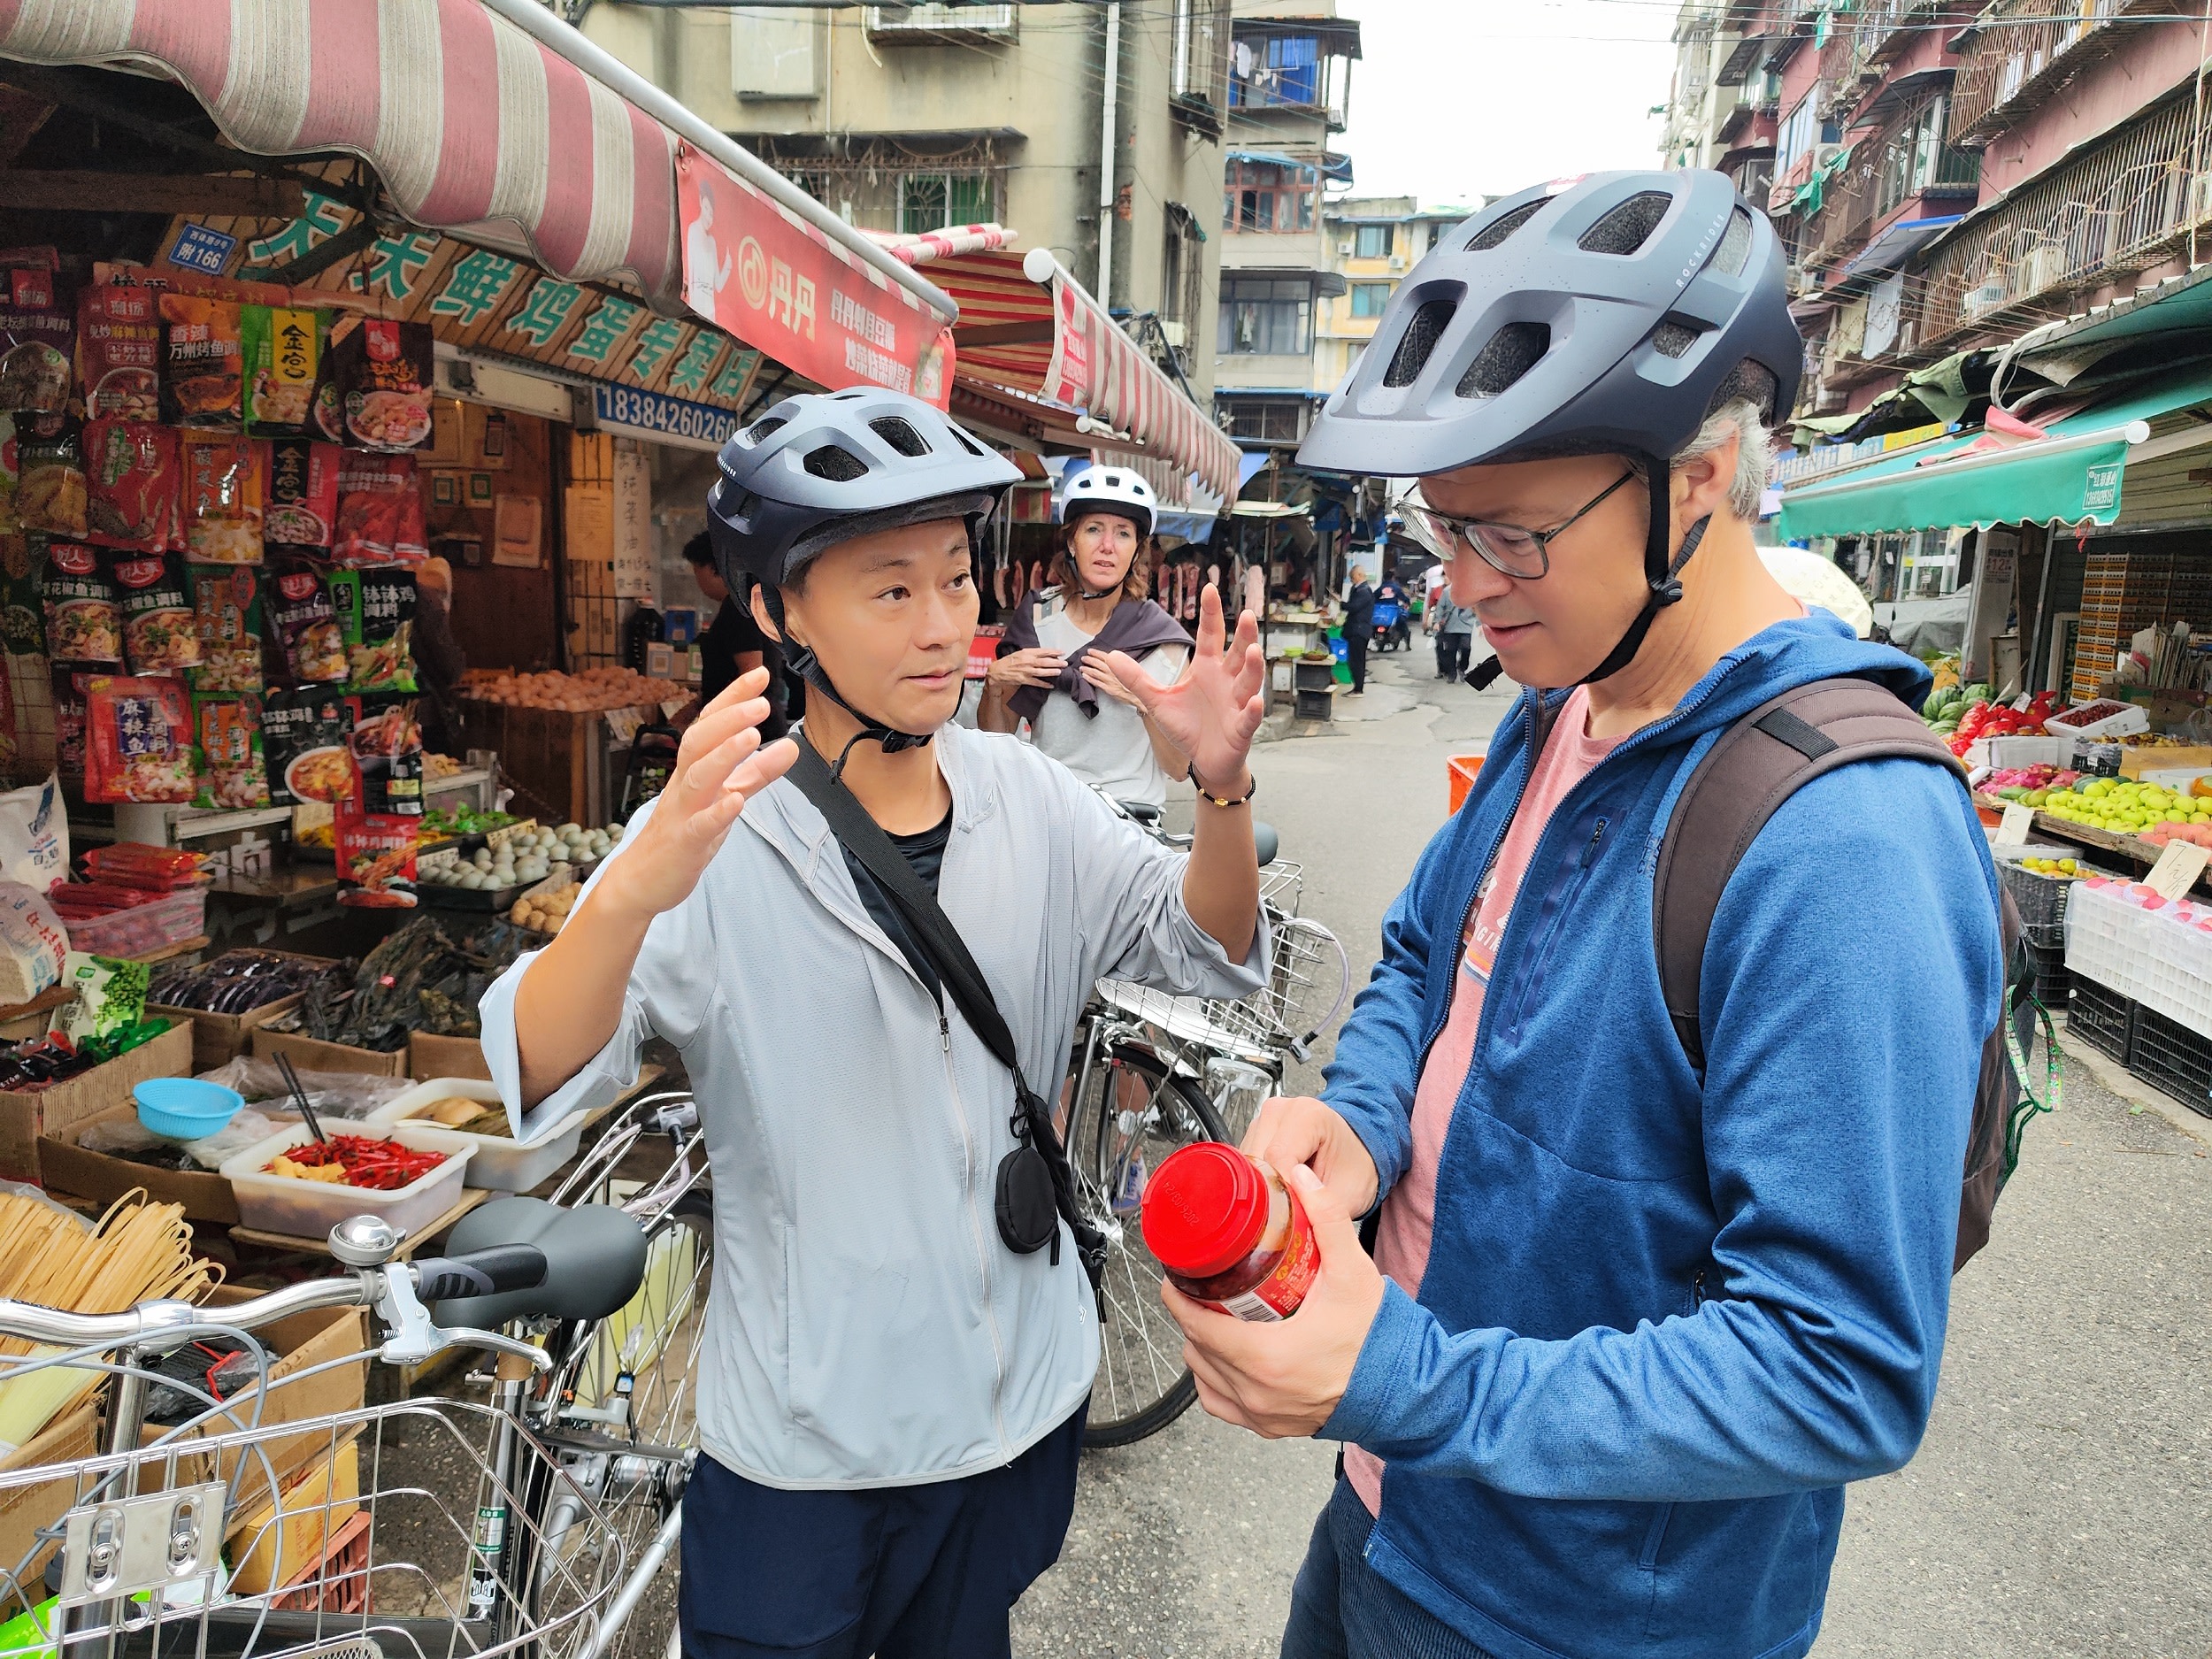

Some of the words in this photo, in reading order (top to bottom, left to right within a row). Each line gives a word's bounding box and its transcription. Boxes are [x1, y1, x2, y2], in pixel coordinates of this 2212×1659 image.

[176, 242, 222, 269] 附166
[1675, 213, 1726, 288] ROCKRIDER
[768, 256, 816, 343] 丹丹
[830, 288, 895, 353] 丹丹郫县豆瓣
[170, 324, 210, 342] 香辣
[280, 324, 310, 380] 金宫
[600, 386, 736, 445] 18384260260
[275, 446, 306, 501] 金宫
[363, 603, 398, 618] 调料
[119, 697, 147, 756] 麻辣鱼
[1162, 1181, 1200, 1227] 2026/03/24
